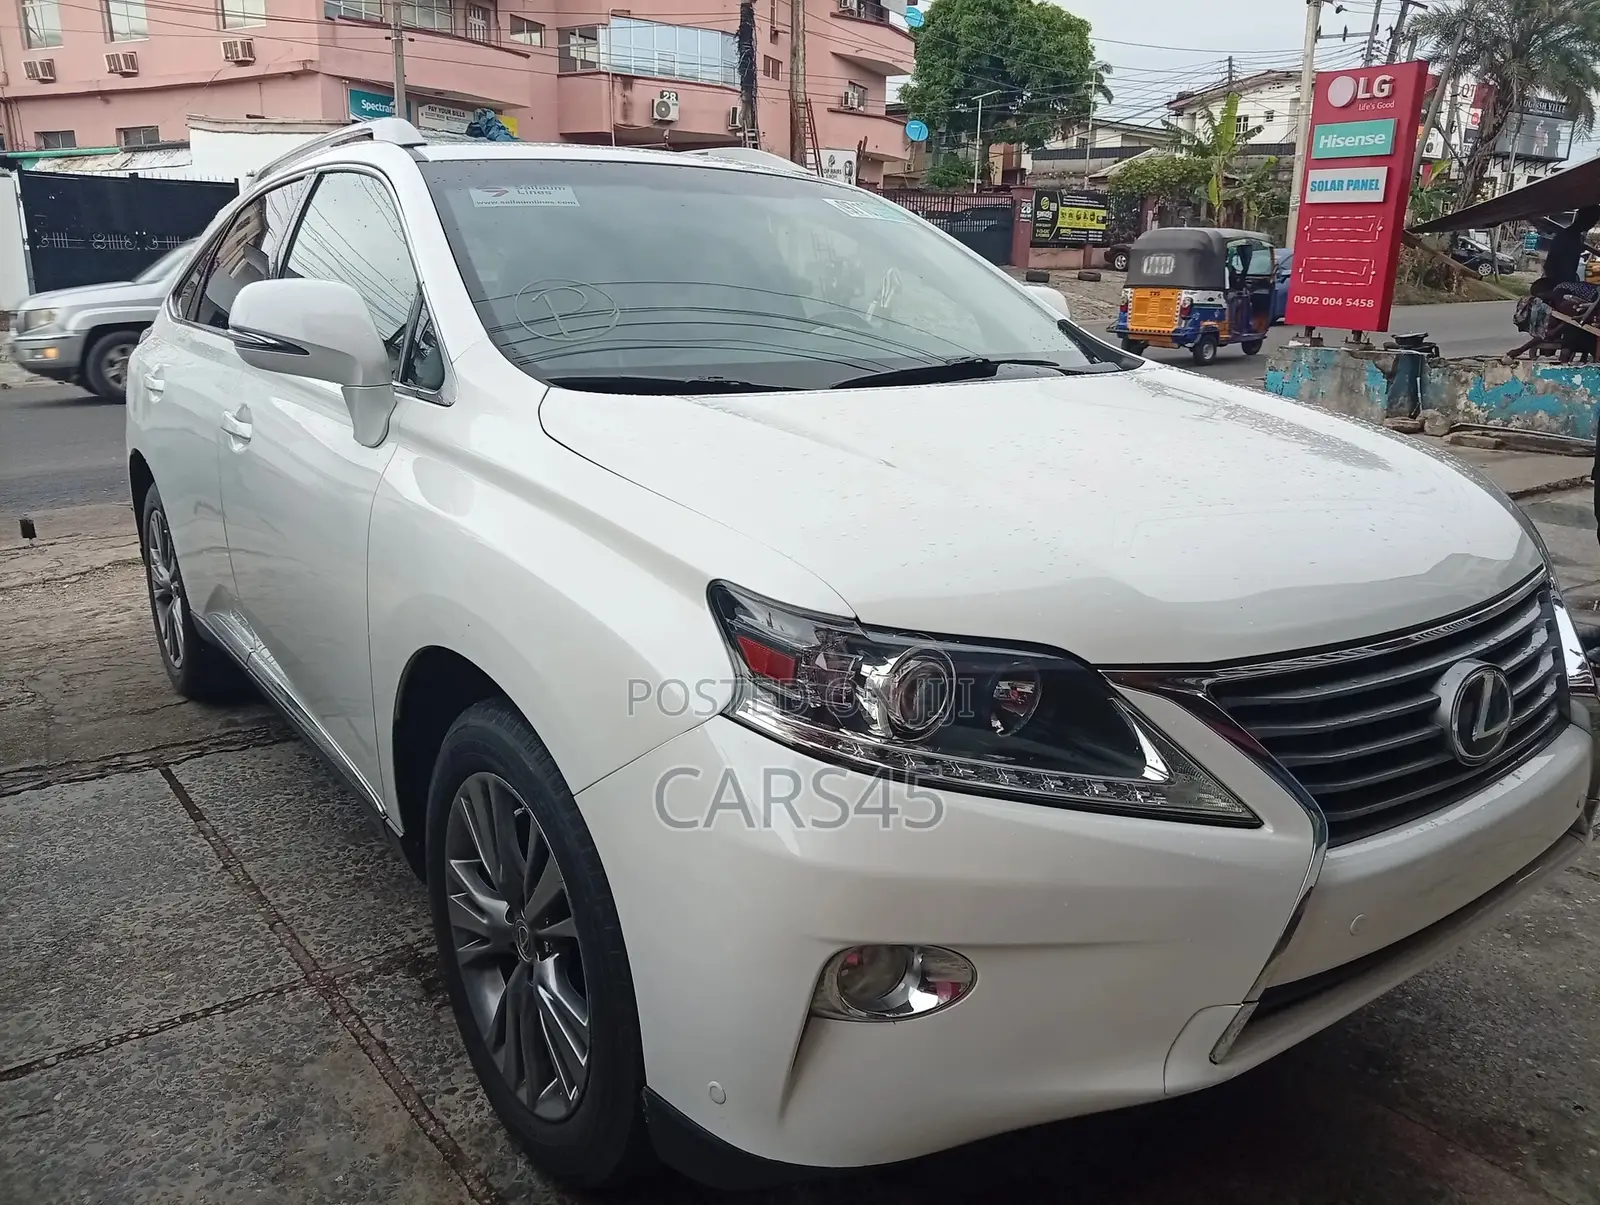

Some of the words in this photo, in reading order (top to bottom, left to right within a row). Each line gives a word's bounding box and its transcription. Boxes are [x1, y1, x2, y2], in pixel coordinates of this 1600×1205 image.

[1357, 73, 1395, 100] LG
[428, 105, 437, 113] PAY
[438, 107, 451, 116] YOUR
[452, 109, 466, 118] BILLS
[1358, 102, 1376, 111] Life's
[1376, 99, 1395, 110] Good
[1319, 132, 1386, 149] Hisense
[1310, 178, 1345, 193] SOLAR
[1346, 177, 1380, 192] PANEL
[1293, 295, 1319, 306] 0902
[1321, 296, 1343, 307] 004
[1345, 297, 1375, 309] 5458
